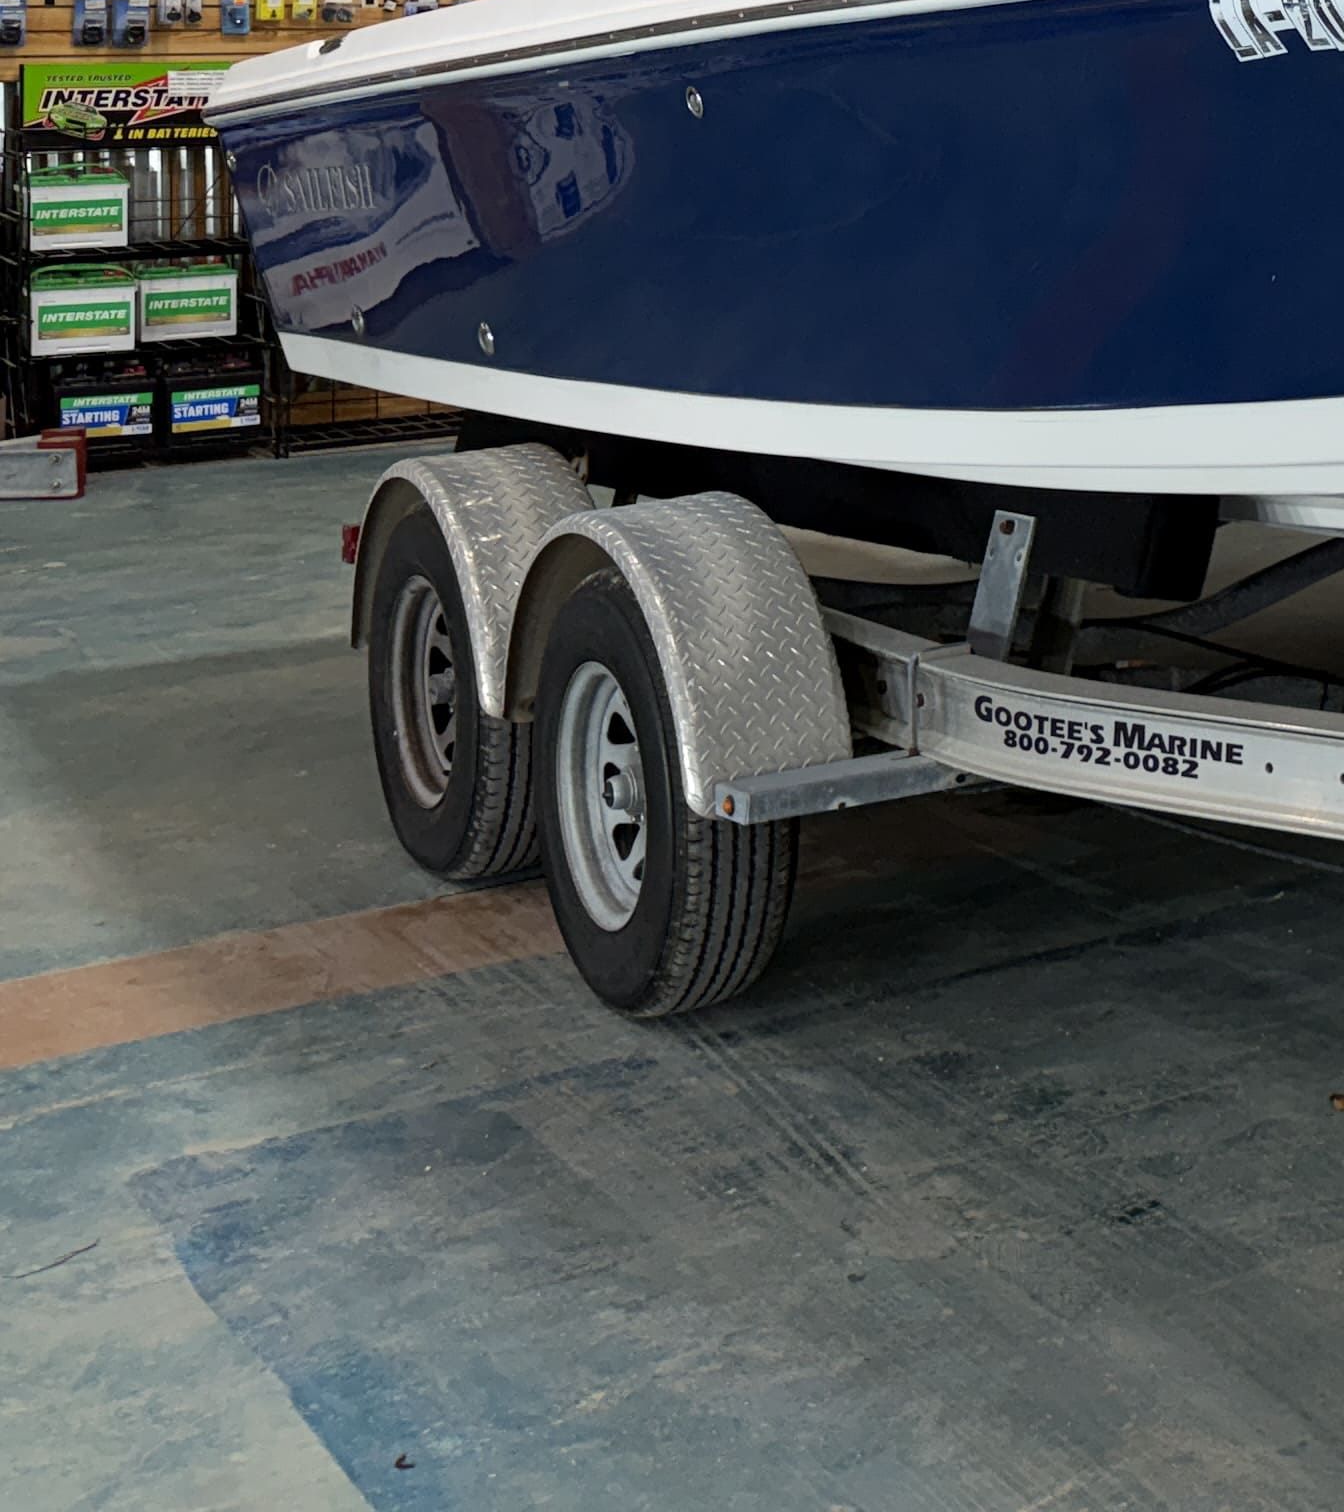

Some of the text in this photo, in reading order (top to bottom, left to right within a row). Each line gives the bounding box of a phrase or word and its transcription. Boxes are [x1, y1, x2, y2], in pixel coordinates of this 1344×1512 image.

[146, 127, 218, 139] BATTERIES
[36, 206, 120, 220] INTERSTATE
[148, 295, 229, 310] INTERSTATE
[42, 309, 127, 323] INTERSTATE
[73, 394, 139, 407] INTERSTATE
[184, 387, 246, 401] INTERSTATE
[62, 410, 120, 425] STARTING
[173, 403, 229, 419] STARTING
[974, 694, 1244, 765] GOOTEE'S MARINE
[1003, 729, 1199, 779] 800-792-0082
